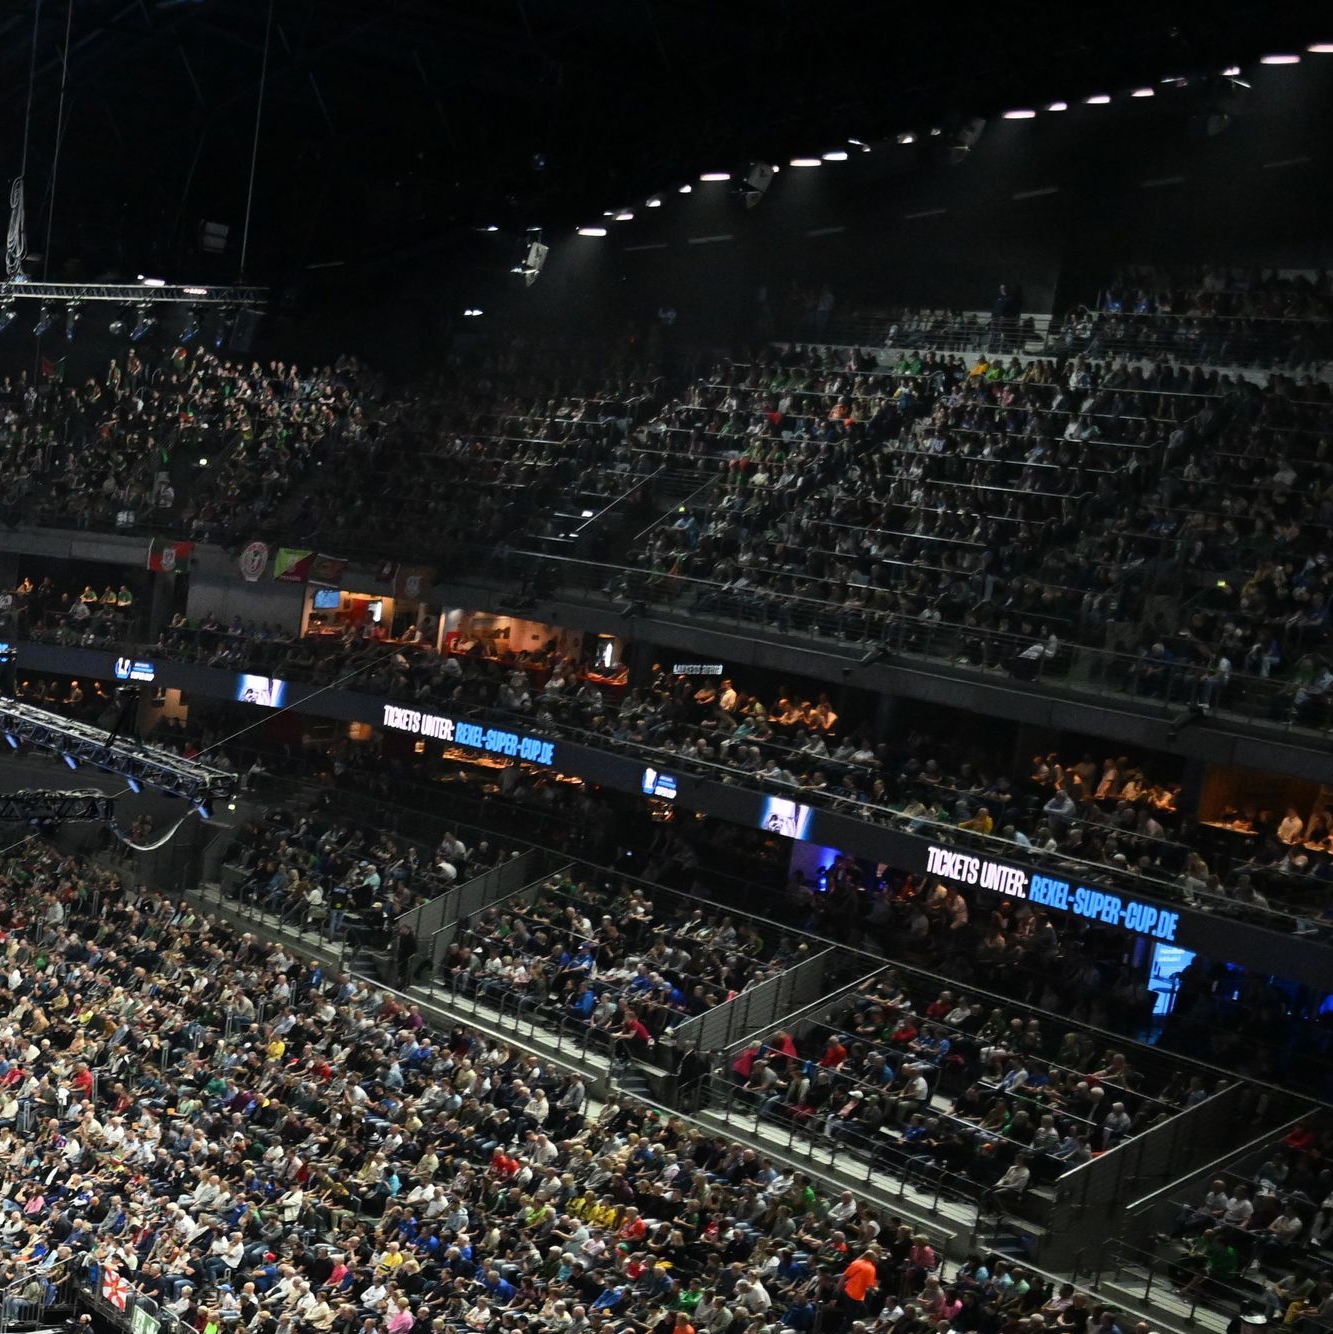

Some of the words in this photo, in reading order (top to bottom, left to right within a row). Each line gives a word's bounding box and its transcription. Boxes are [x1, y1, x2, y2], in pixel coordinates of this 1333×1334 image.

[383, 704, 421, 733] TICKETS
[420, 714, 455, 742] UNTER:
[454, 721, 555, 766] REXEL-SUPER-CUP.DE
[927, 846, 979, 885] TICKETS
[980, 861, 1029, 899] UNTER:
[1029, 874, 1179, 941] REXEL-SUPER-CUP.DE
